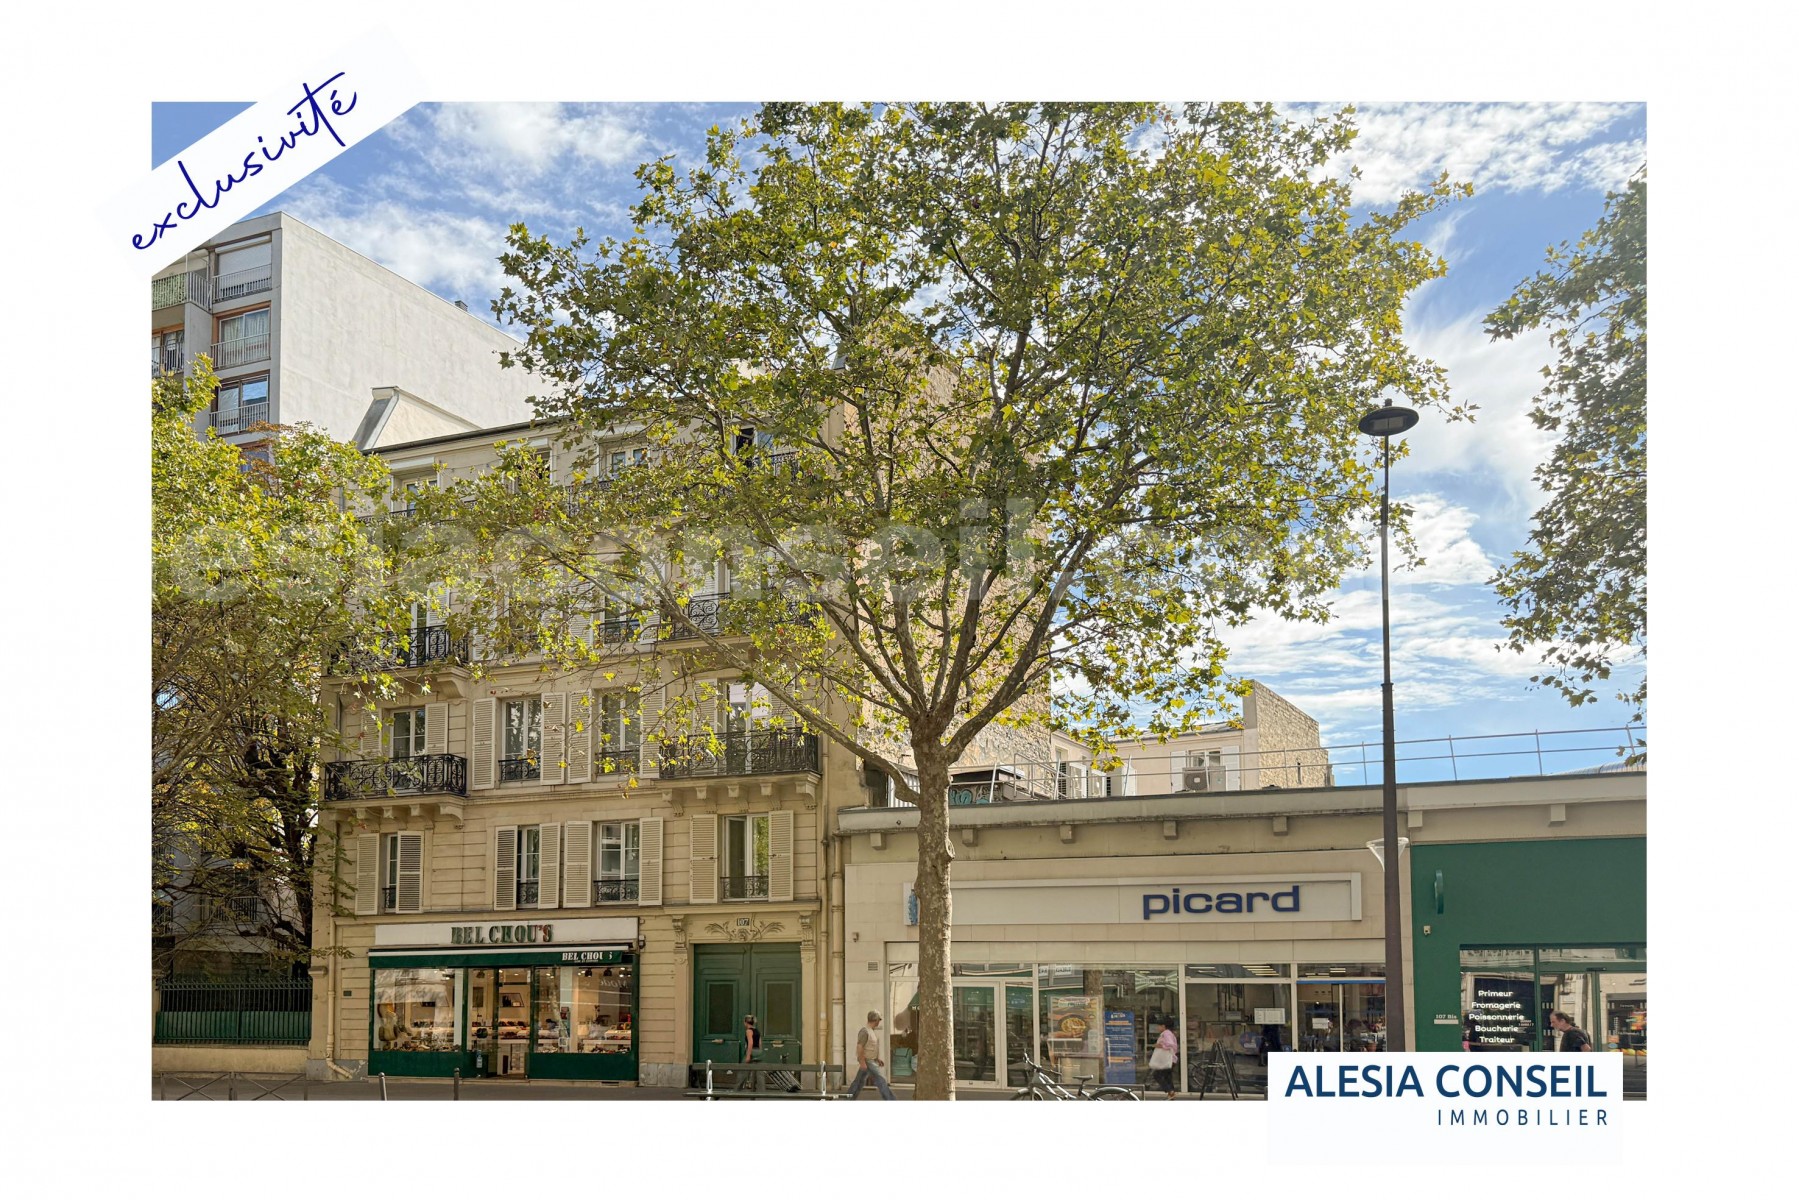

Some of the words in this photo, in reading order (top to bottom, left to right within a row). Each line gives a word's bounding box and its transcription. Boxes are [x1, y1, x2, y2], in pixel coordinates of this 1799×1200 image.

[1143, 885, 1300, 920] picard
[451, 926, 484, 944] BEL
[488, 924, 553, 944] CHOU'S
[562, 952, 579, 961] BEL
[1471, 1002, 1521, 1011] Fromagerie
[1469, 1013, 1525, 1021] Poissonnerie
